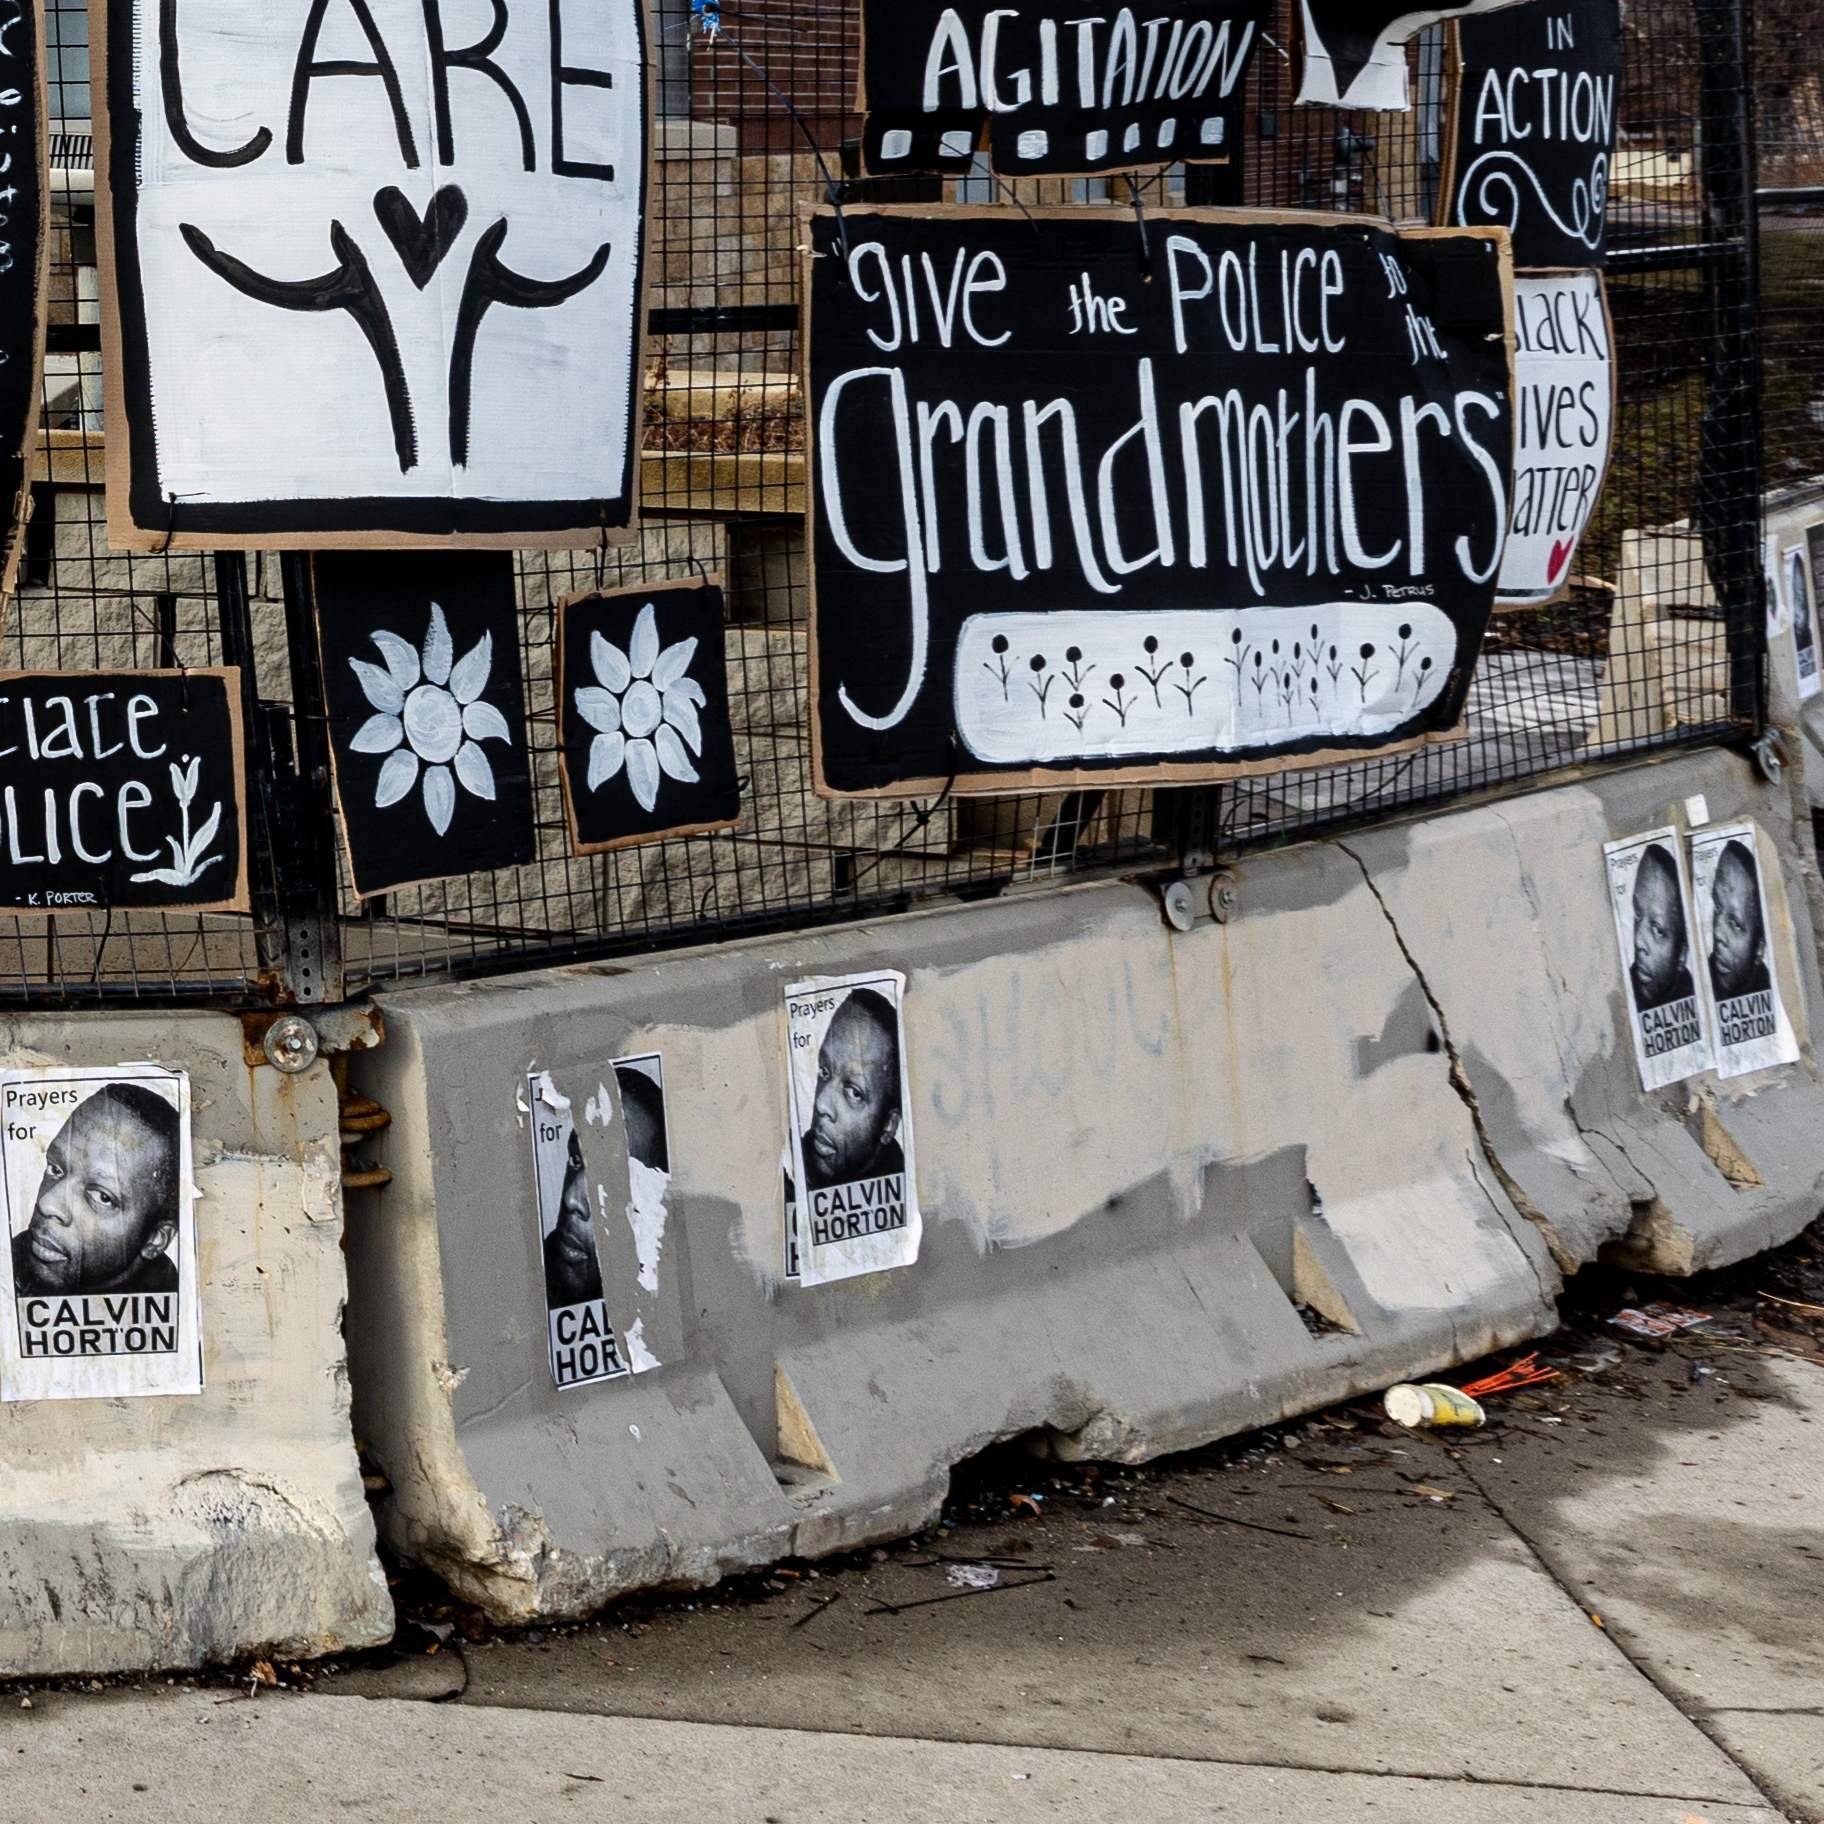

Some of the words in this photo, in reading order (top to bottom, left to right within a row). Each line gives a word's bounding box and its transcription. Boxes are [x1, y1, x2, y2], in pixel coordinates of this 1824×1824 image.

[1546, 15, 1574, 50] IN
[922, 7, 1256, 113] AGITATION
[1473, 66, 1614, 146] ACTION
[1068, 272, 1139, 335] the
[789, 996, 836, 1021] Prayers
[1642, 998, 1696, 1034] CALVIN
[1719, 991, 1773, 1024] CALVIN
[792, 1030, 813, 1050] for
[1644, 1020, 1702, 1058] HORTON
[1721, 1014, 1777, 1047] HORTON
[5, 1086, 79, 1110] Prayers
[7, 1121, 37, 1142] for
[813, 1175, 902, 1218] CALVIN
[813, 1201, 906, 1246] HORTON
[25, 1295, 172, 1329] CALVIN
[25, 1325, 176, 1357] HORTON
